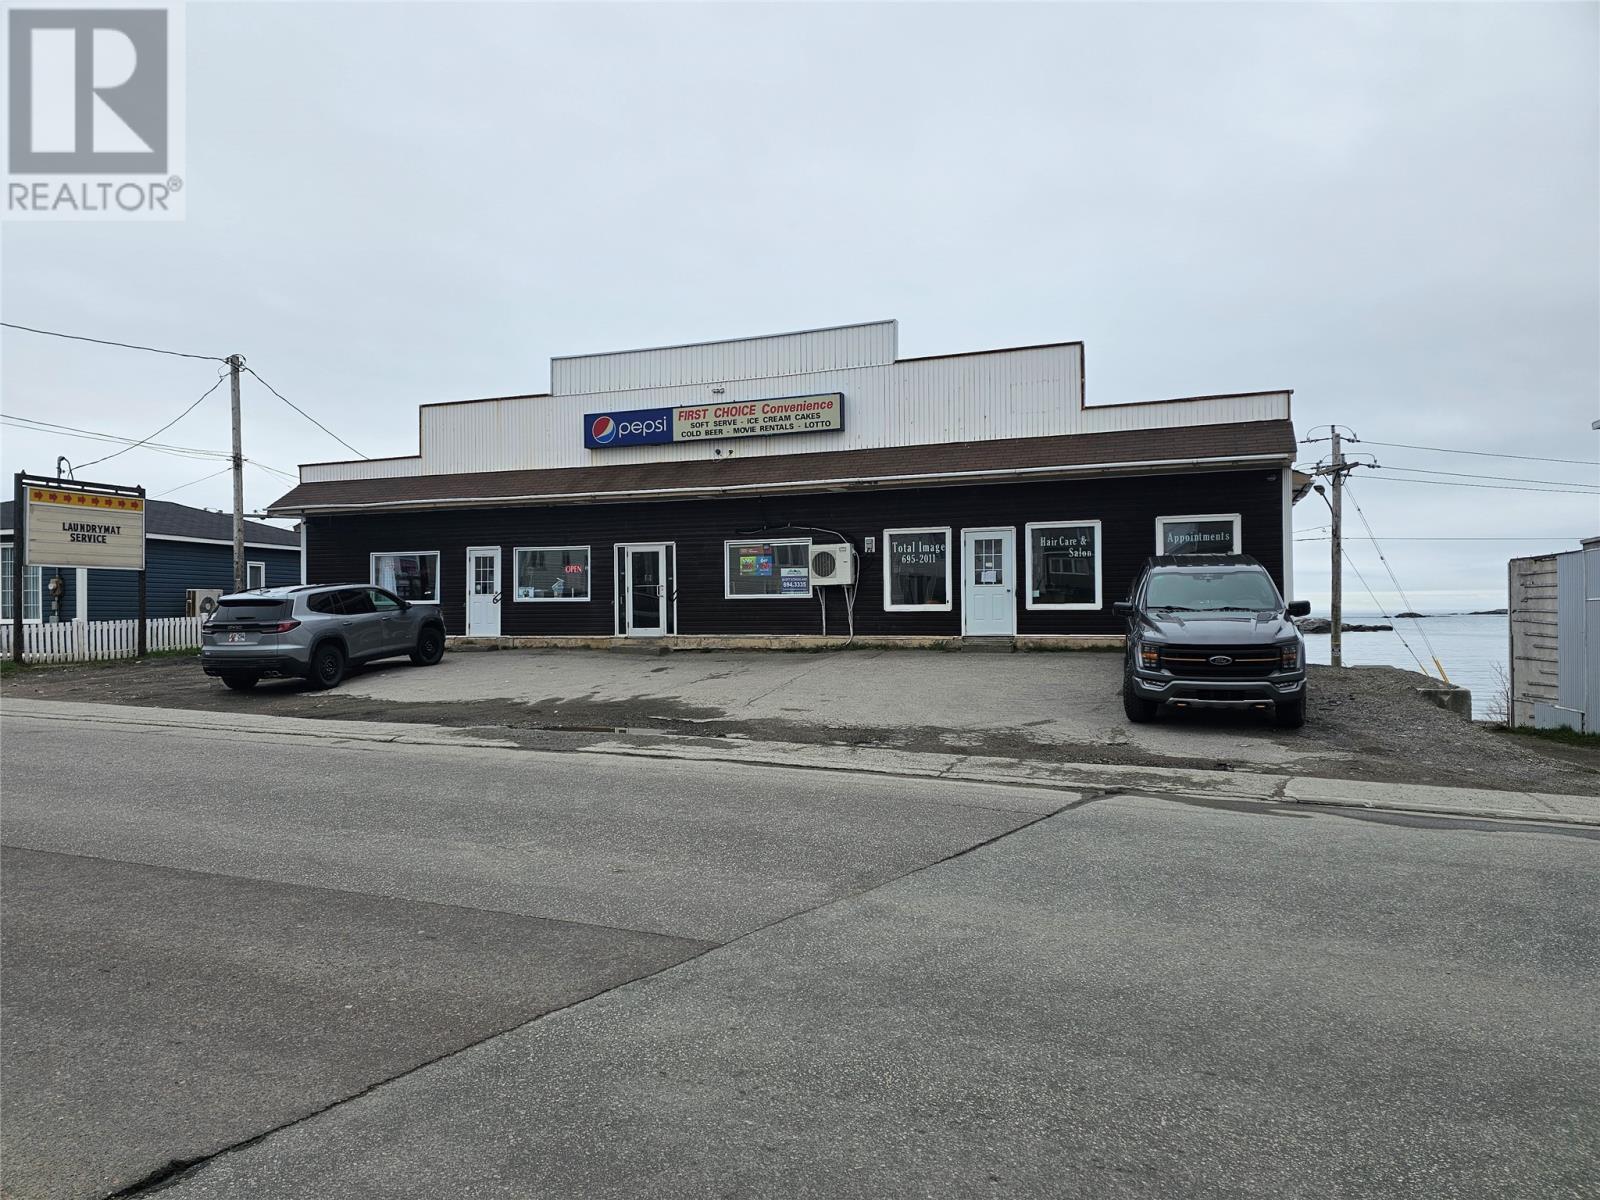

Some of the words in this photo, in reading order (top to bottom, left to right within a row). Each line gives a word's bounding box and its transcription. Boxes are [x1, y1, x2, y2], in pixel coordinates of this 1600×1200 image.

[678, 408, 709, 421] FIRST
[714, 404, 756, 419] CHOICE
[761, 399, 834, 414] Convenience
[690, 420, 710, 429] SOFT
[713, 419, 738, 427] SERVE
[746, 417, 759, 425] ICE
[763, 414, 791, 423] CREAM
[794, 412, 821, 421] CAKES
[618, 416, 667, 439] pepsi
[681, 430, 702, 438] COLD
[704, 428, 724, 436] BEER
[733, 426, 757, 435] MOVIE
[759, 423, 794, 432] RENTALS
[804, 420, 832, 429] LOTTO
[62, 522, 121, 535] LAUNDRYMAT
[70, 532, 107, 544] SERVICE
[1040, 536, 1058, 547] Hair
[1059, 536, 1078, 547] Care
[1080, 536, 1090, 546] &
[1167, 531, 1231, 544] Appointments
[892, 541, 915, 553] Total
[919, 541, 945, 554] Image
[1068, 547, 1092, 558] Salon
[901, 554, 936, 564] 695-2011
[565, 565, 582, 574] OPEN
